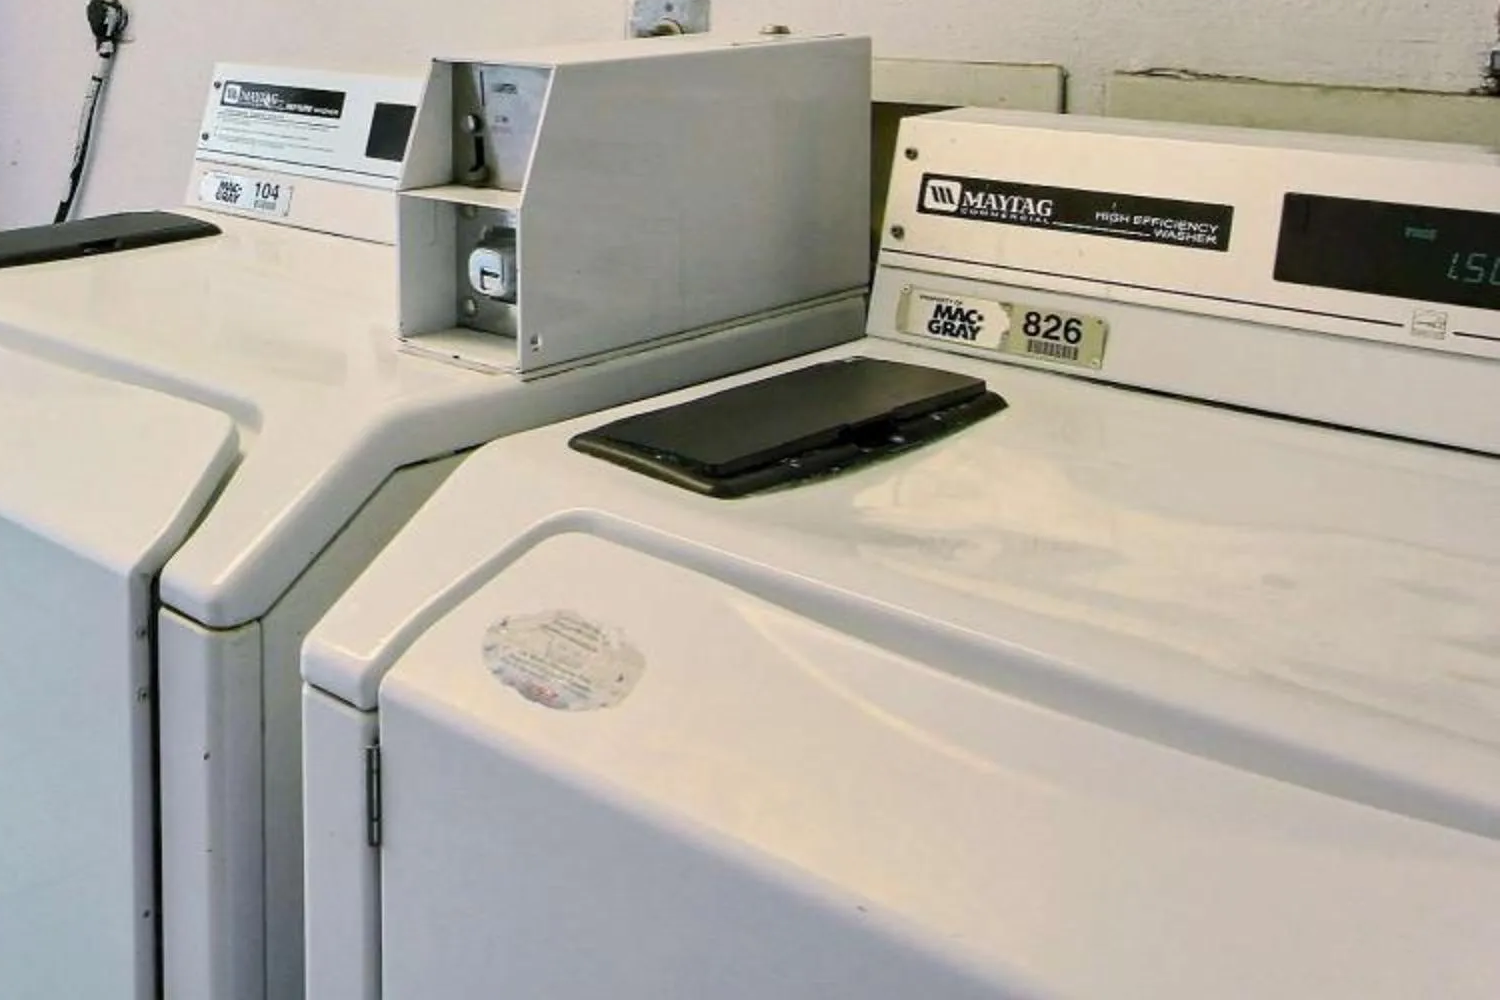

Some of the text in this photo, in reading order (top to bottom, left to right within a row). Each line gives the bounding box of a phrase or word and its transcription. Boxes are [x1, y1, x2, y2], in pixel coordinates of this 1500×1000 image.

[255, 181, 280, 201] 104
[962, 191, 1054, 217] MAYTAG
[1095, 211, 1220, 234] HIGH EFFICIENCY
[1153, 228, 1219, 245] WASHER
[927, 318, 983, 342] GRAY
[1022, 311, 1083, 345] 826
